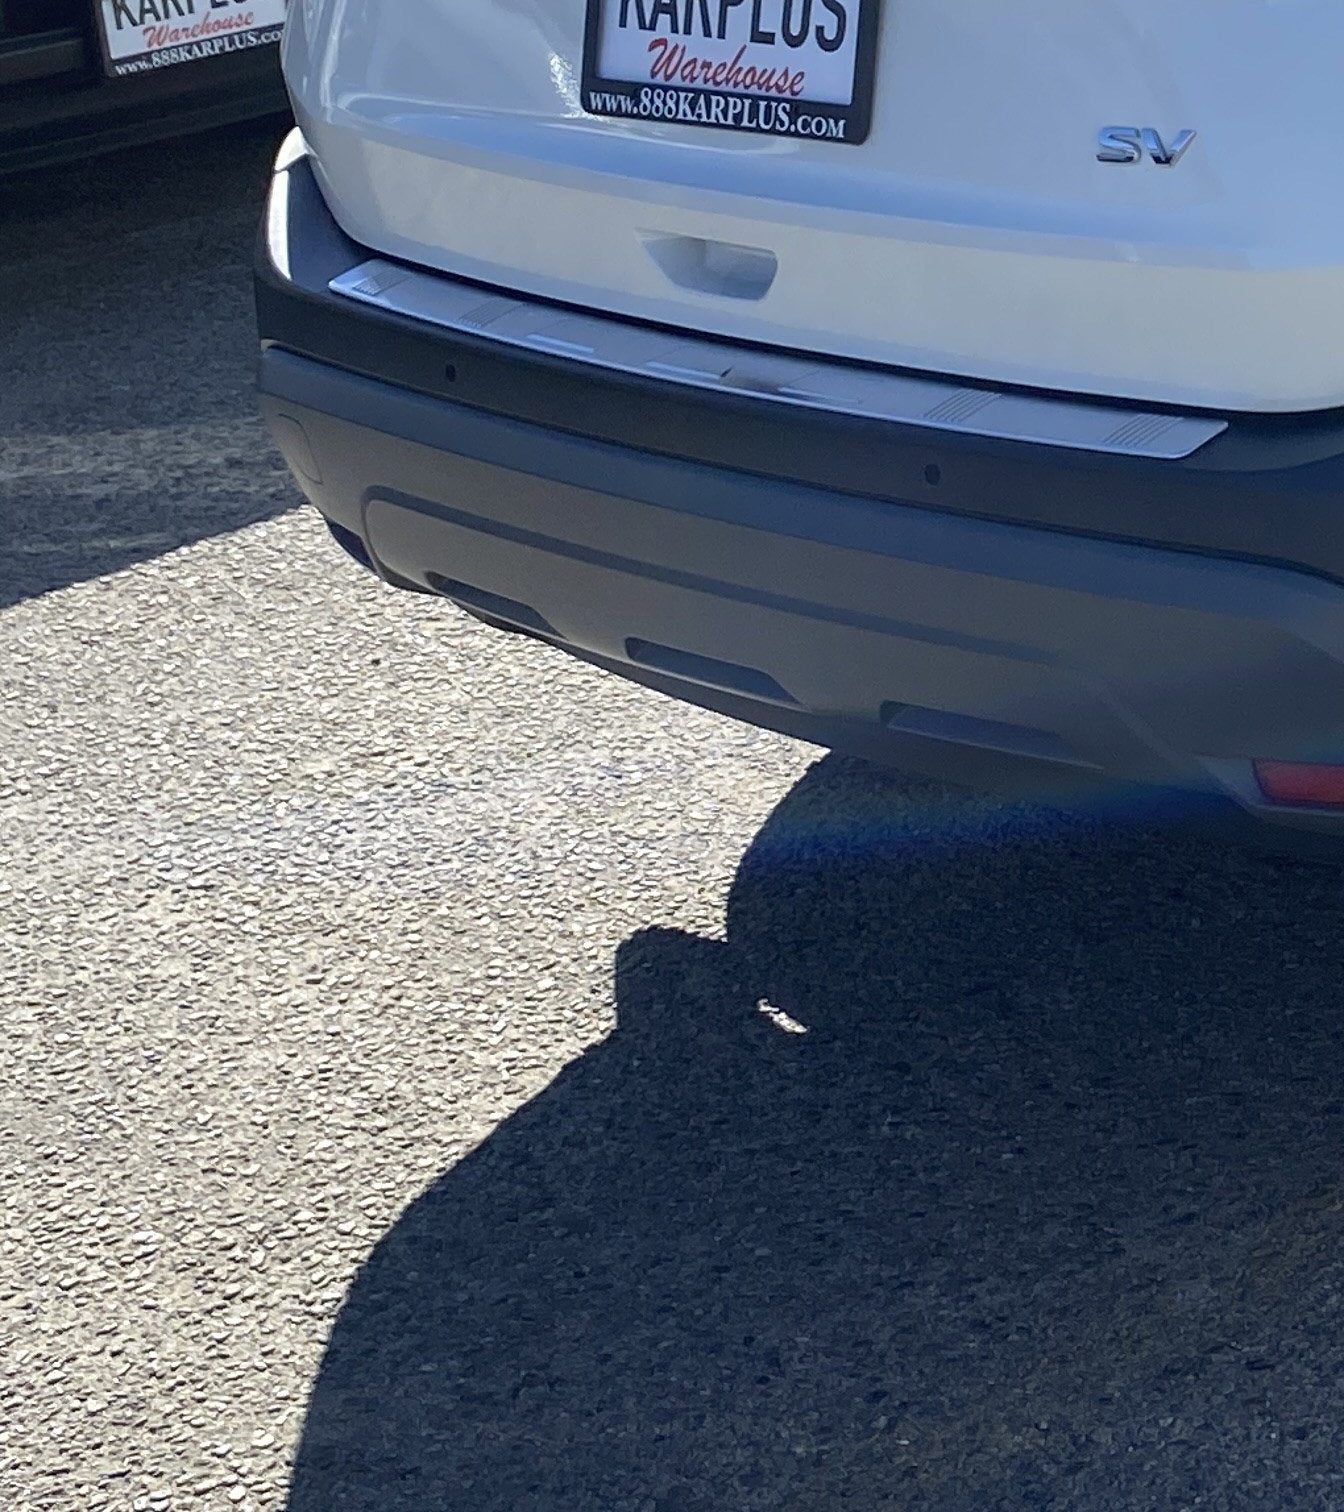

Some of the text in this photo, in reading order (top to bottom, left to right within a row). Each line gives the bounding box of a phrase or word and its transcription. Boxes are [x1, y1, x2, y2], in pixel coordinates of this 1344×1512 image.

[142, 10, 254, 49] Warehouse
[647, 38, 805, 97] Warehouse
[1096, 126, 1198, 167] SV
